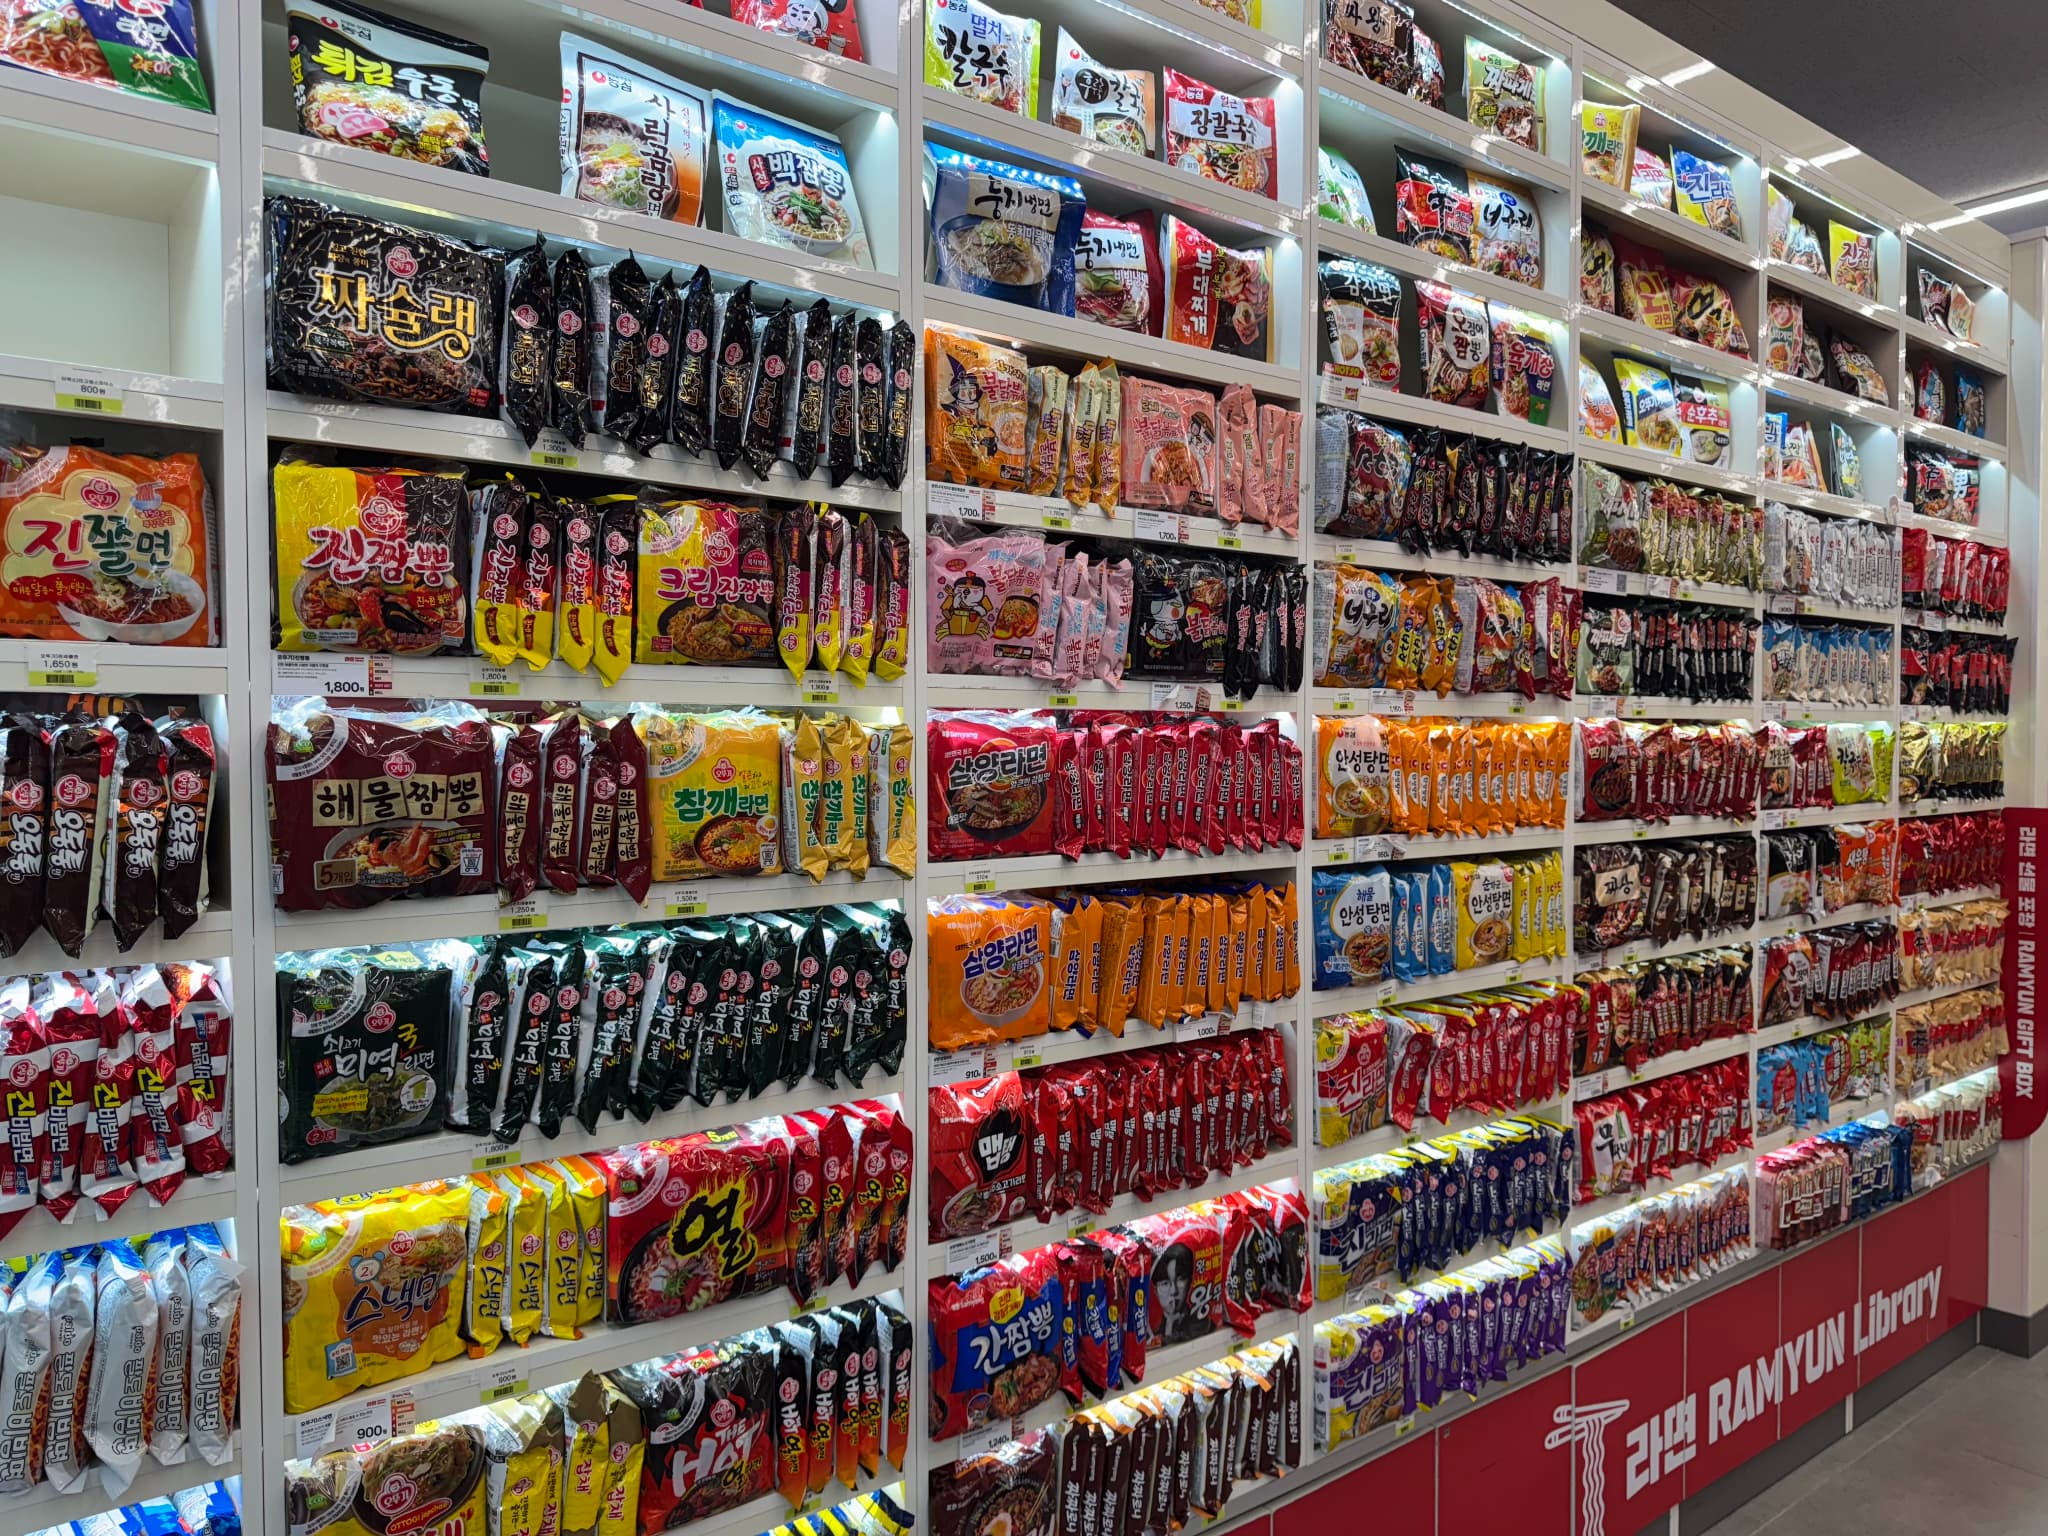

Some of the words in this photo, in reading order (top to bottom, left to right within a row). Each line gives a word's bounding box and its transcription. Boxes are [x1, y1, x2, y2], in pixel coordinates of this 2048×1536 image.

[971, 13, 1002, 42] 멸치
[311, 39, 394, 88] 튀김
[395, 67, 460, 103] 우동
[937, 25, 1014, 89] 칼국수
[1190, 109, 1257, 146] 장칼국수
[767, 151, 846, 199] 백짬뽕
[975, 174, 1022, 220] 둥지
[1483, 200, 1535, 233] 너구리
[1075, 231, 1113, 270] 둥지
[1187, 247, 1209, 336] 부대찌개
[1344, 273, 1393, 302] 감자면
[313, 269, 477, 361] 짜슐랭
[1451, 306, 1485, 334] 오징어
[1452, 334, 1483, 362] 짬뽕
[1507, 340, 1555, 378] 육개장
[1686, 405, 1719, 424] 순후추
[22, 514, 173, 577] 진쫄면
[301, 526, 455, 587] 진짬뽕
[1344, 598, 1395, 631] 너구리
[949, 742, 1048, 788] 삼양라면
[1336, 748, 1390, 773] 안성탕면
[316, 775, 480, 823] 해물짬뽕
[674, 786, 770, 824] 참깨라면
[2018, 826, 2036, 857] 라면
[1339, 903, 1391, 927] 안성탕면
[1471, 892, 1511, 914] 안성탕면
[961, 923, 1040, 981] 삼양라면
[2016, 940, 2036, 1016] RAMYUN
[2015, 1018, 2034, 1060] GIFT
[335, 1041, 399, 1083] 미역
[403, 1049, 436, 1071] 라면
[2015, 1062, 2033, 1100] BOX
[344, 1272, 442, 1333] 스낵면
[969, 1300, 1055, 1375] 간짬뽕
[1626, 1393, 1696, 1500] 라면
[1708, 1311, 1845, 1446] RAMYUN
[1853, 1265, 1942, 1356] Library
[717, 1417, 748, 1443] THE
[672, 1419, 762, 1498] HOT
[390, 1514, 420, 1532] OTTOGI
